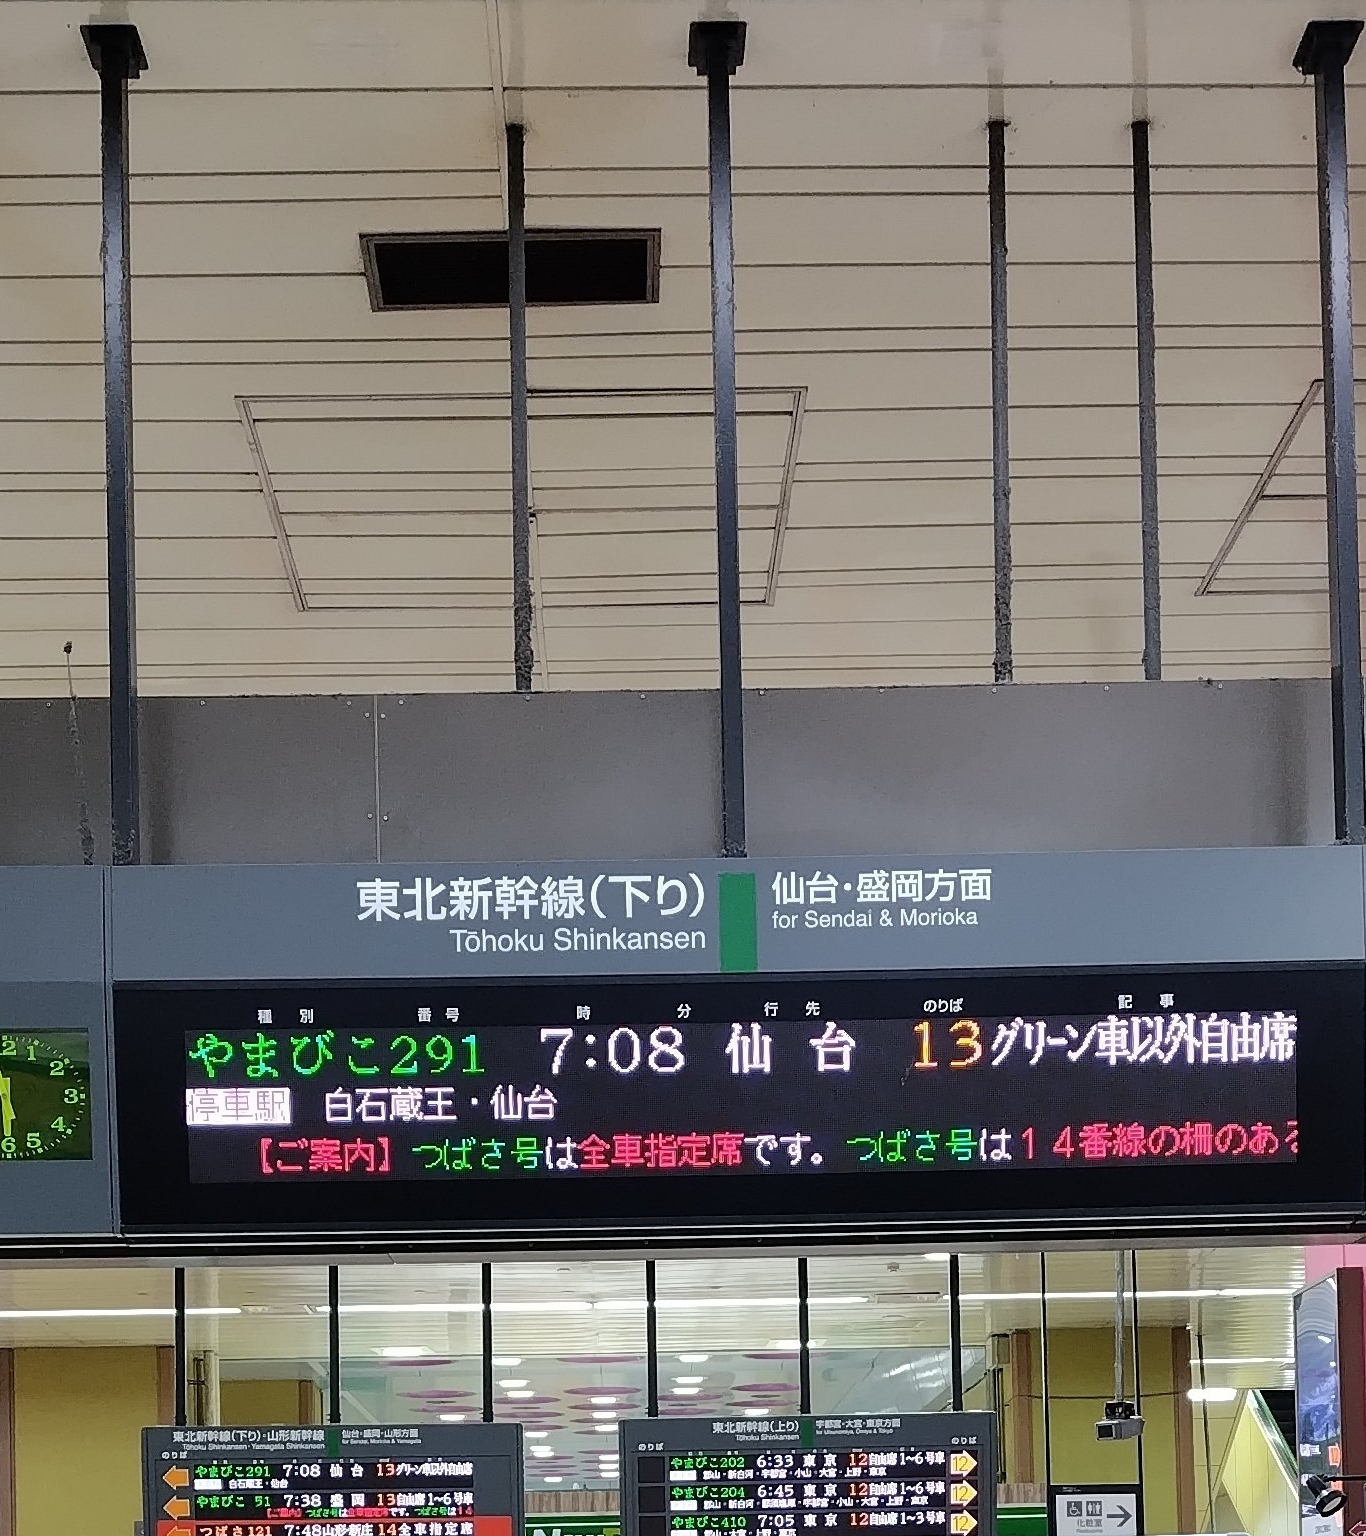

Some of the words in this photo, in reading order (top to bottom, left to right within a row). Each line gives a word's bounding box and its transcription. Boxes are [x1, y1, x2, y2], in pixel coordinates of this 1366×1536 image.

[773, 870, 992, 906] 仙台・盛岡方面
[772, 909, 798, 929] for
[804, 908, 872, 929] Sendai
[878, 908, 893, 927] &
[900, 906, 978, 927] Morioka
[450, 928, 544, 953] Tōhoku
[553, 927, 706, 951] Shinkansen
[923, 998, 963, 1013] のりば
[539, 1026, 685, 1076] 7:08
[914, 1019, 982, 1070] 13
[991, 1014, 1296, 1066] グリーン車以外自由席
[757, 1455, 794, 1467] 6:33
[849, 1454, 868, 1466] 12
[283, 1463, 321, 1478] 7:08
[757, 1485, 794, 1497] 6:45
[849, 1483, 868, 1496] 12
[284, 1494, 321, 1508] 7:38
[758, 1515, 794, 1527] 7:05
[850, 1513, 868, 1525] 12
